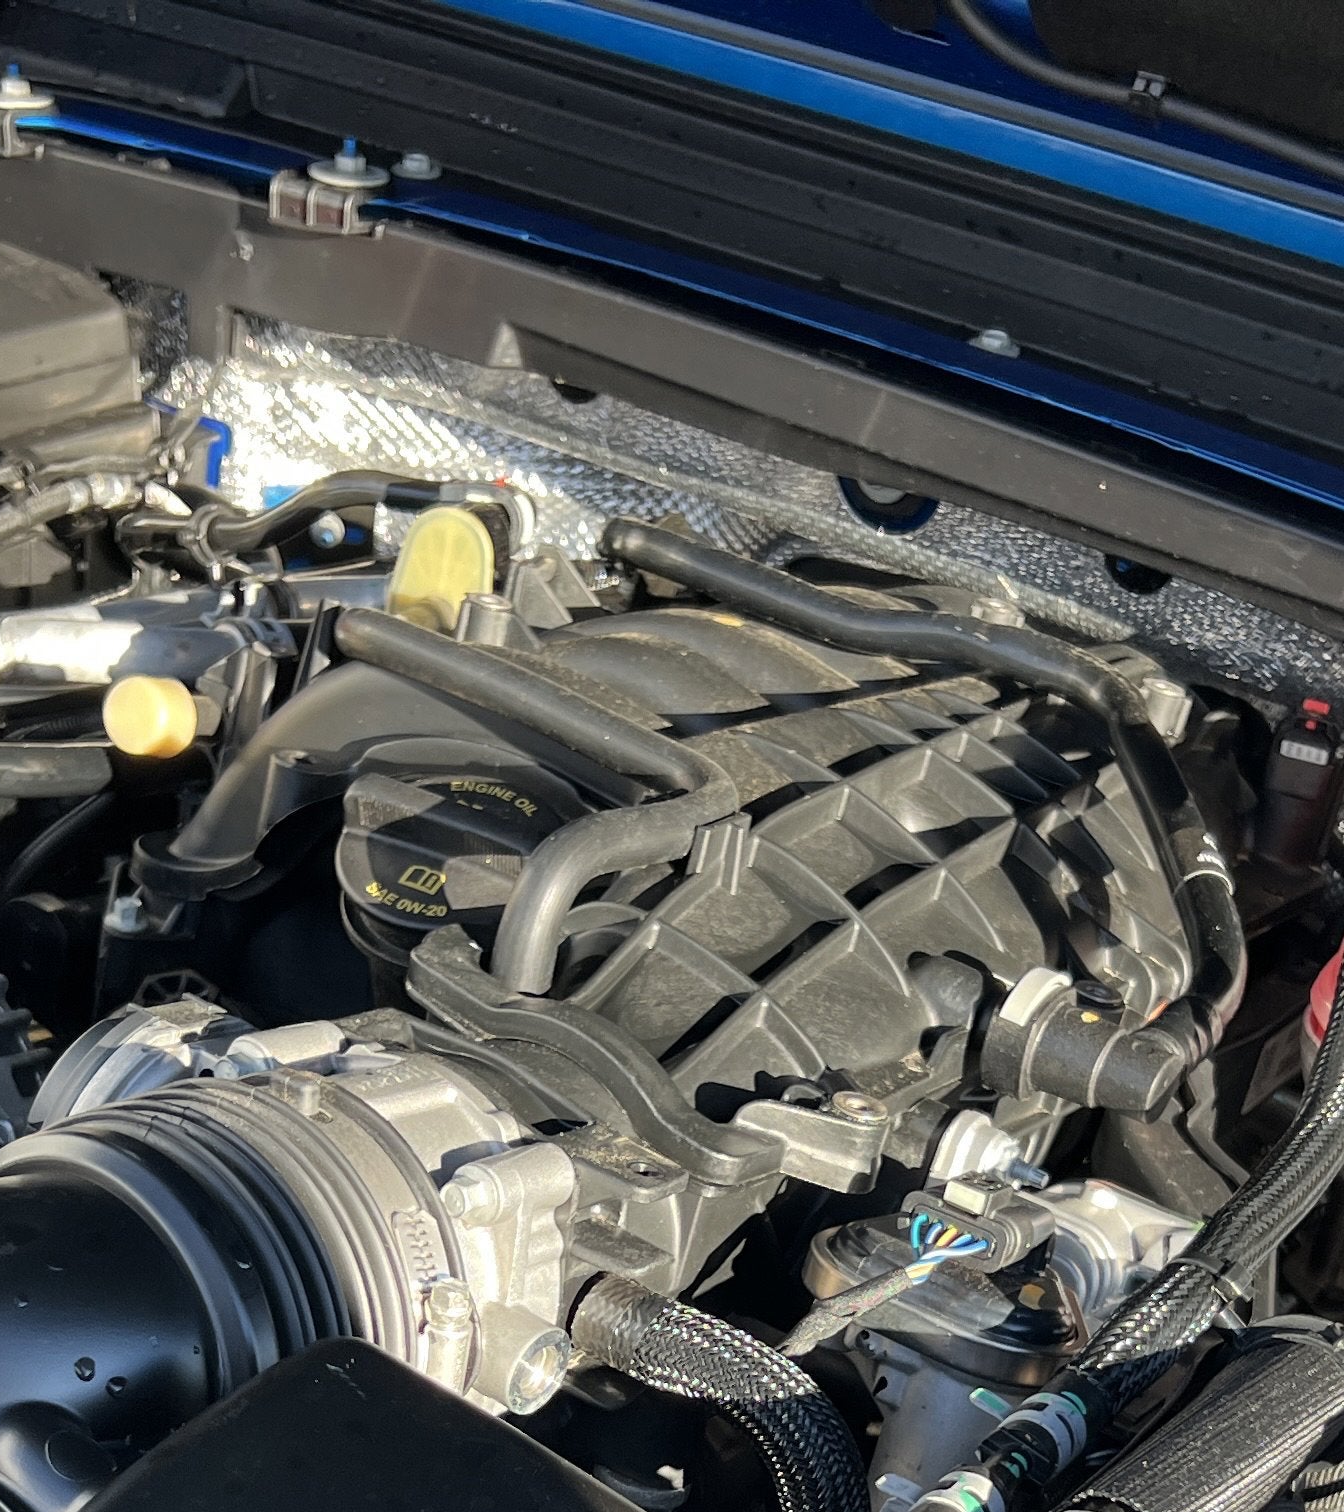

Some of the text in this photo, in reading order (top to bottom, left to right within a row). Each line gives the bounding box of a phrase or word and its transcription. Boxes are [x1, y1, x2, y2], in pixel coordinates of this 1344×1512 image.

[450, 780, 538, 818] ENGINE OIL
[396, 898, 448, 918] 0W-20
